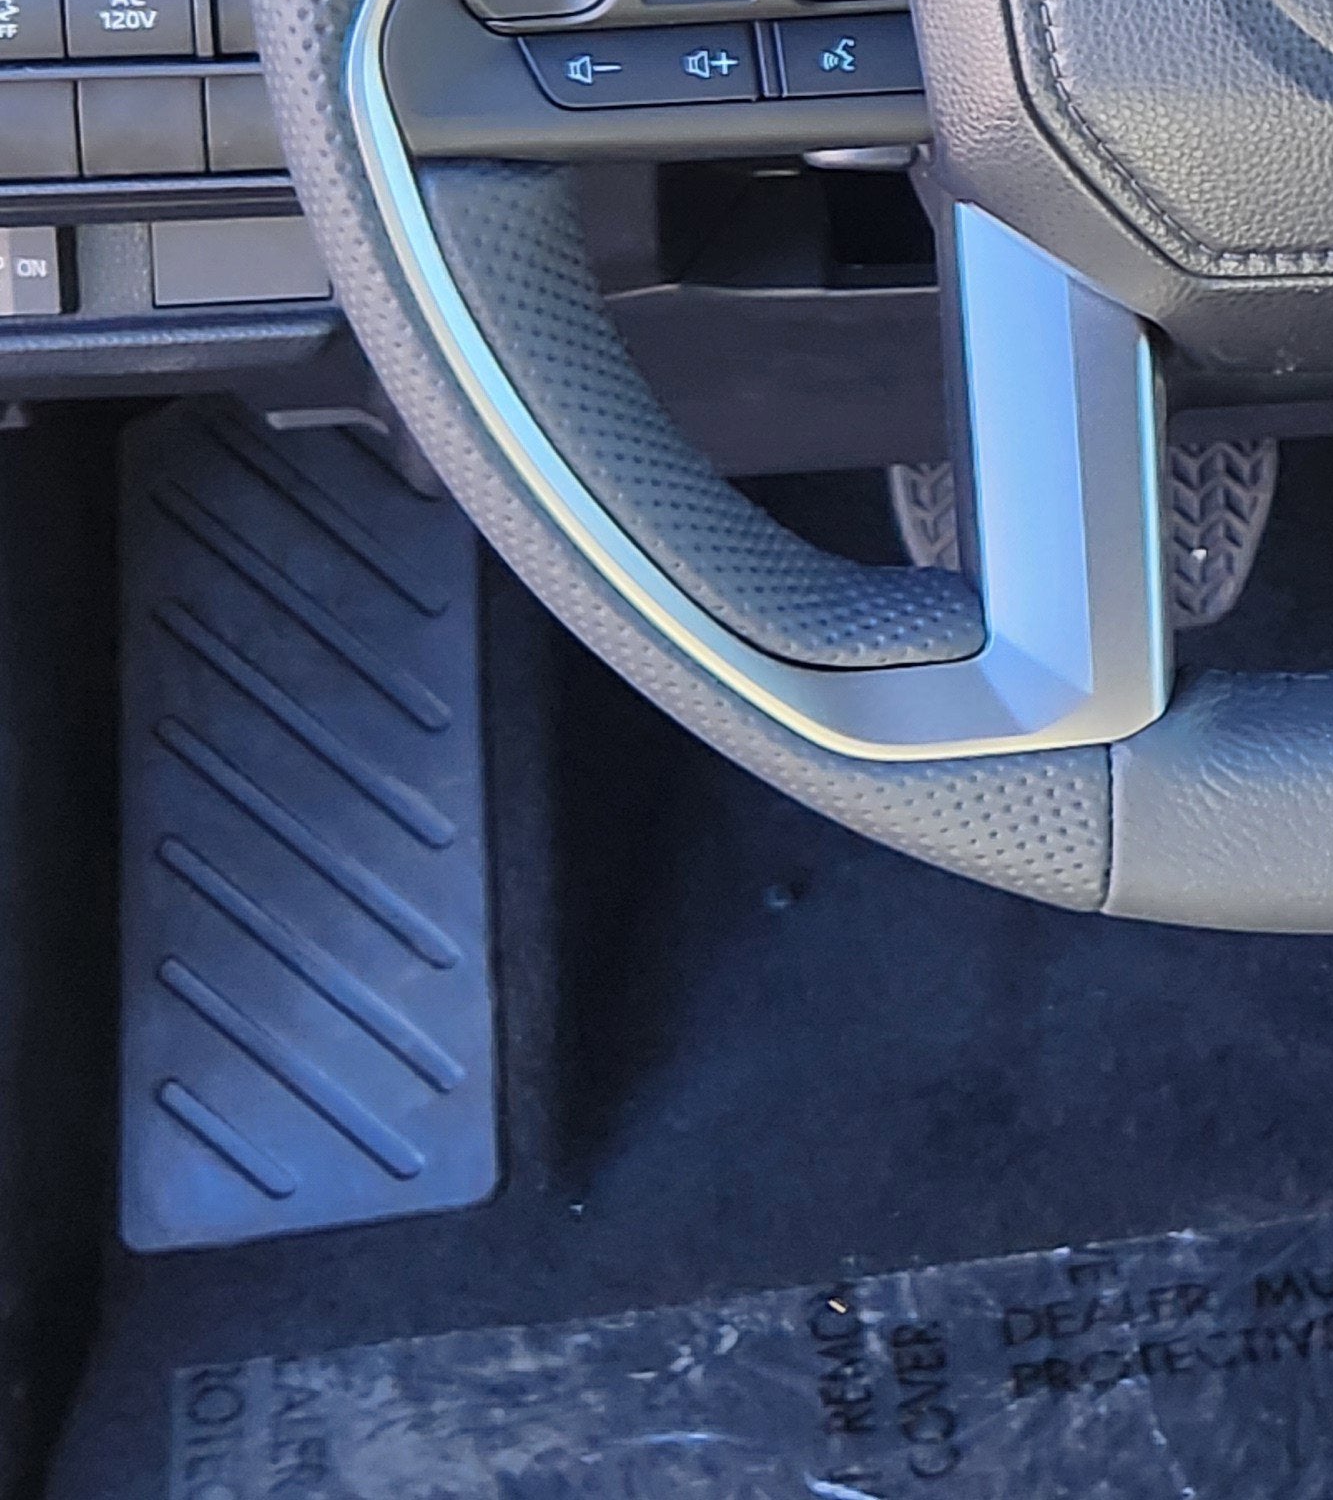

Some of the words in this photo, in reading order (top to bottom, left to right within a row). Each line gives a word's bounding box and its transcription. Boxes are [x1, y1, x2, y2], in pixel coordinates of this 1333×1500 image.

[98, 10, 158, 30] 120V
[0, 23, 19, 39] FF
[18, 258, 47, 277] ON
